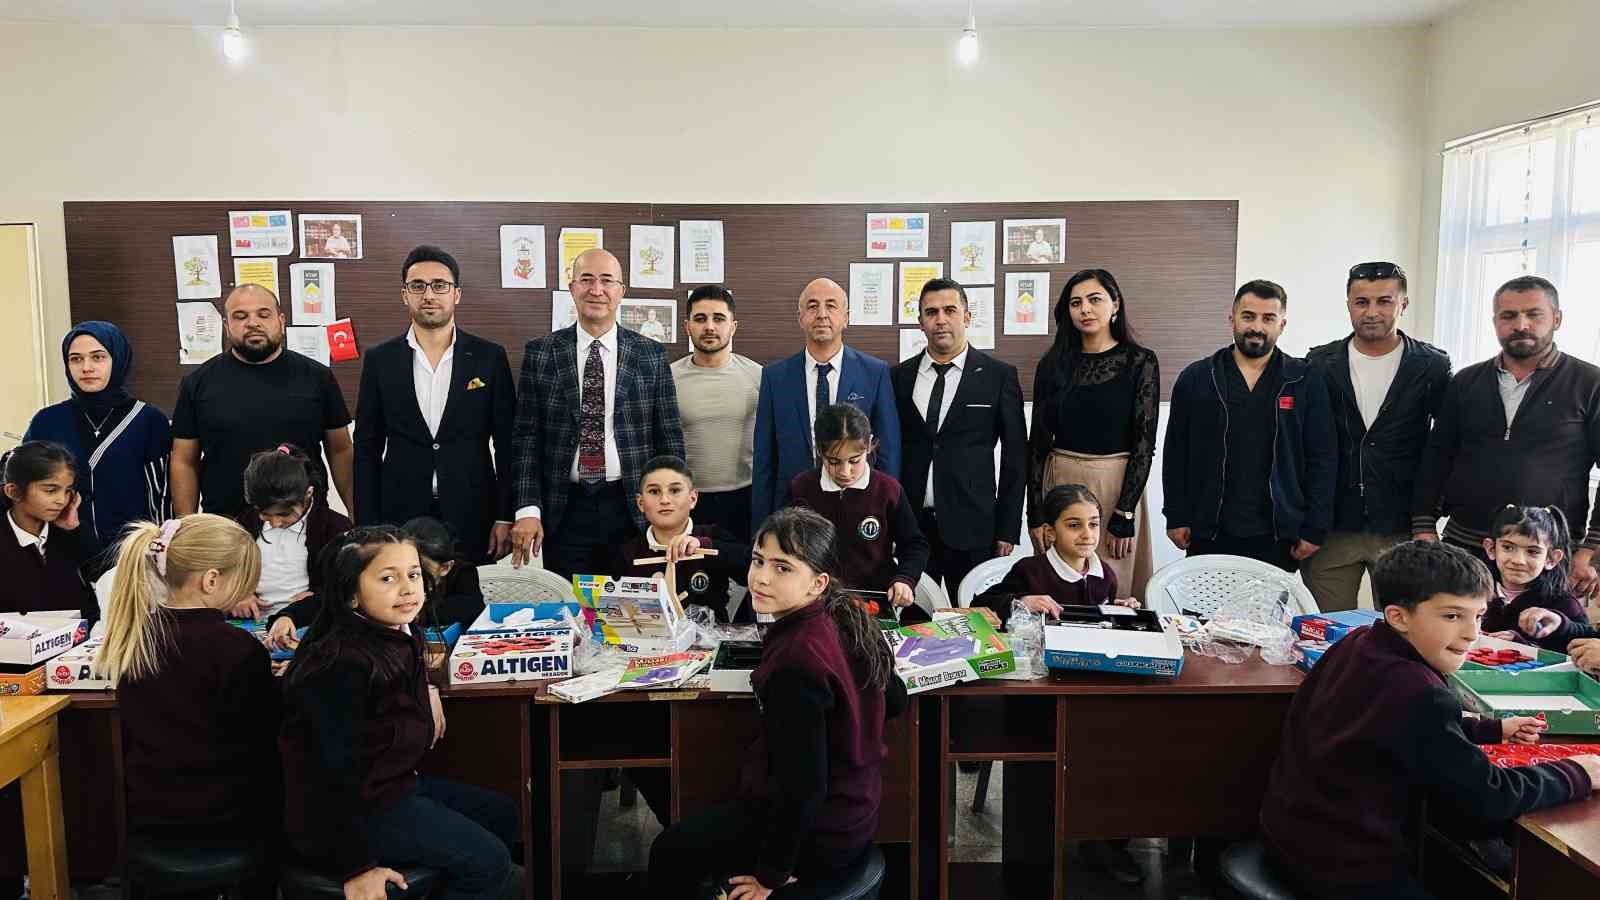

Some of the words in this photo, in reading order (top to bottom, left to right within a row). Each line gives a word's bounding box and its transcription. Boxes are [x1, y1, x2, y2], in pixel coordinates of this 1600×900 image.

[35, 632, 72, 654] ALTIGEN
[488, 630, 570, 639] ALTIGEN
[480, 656, 569, 675] ALTIGEN
